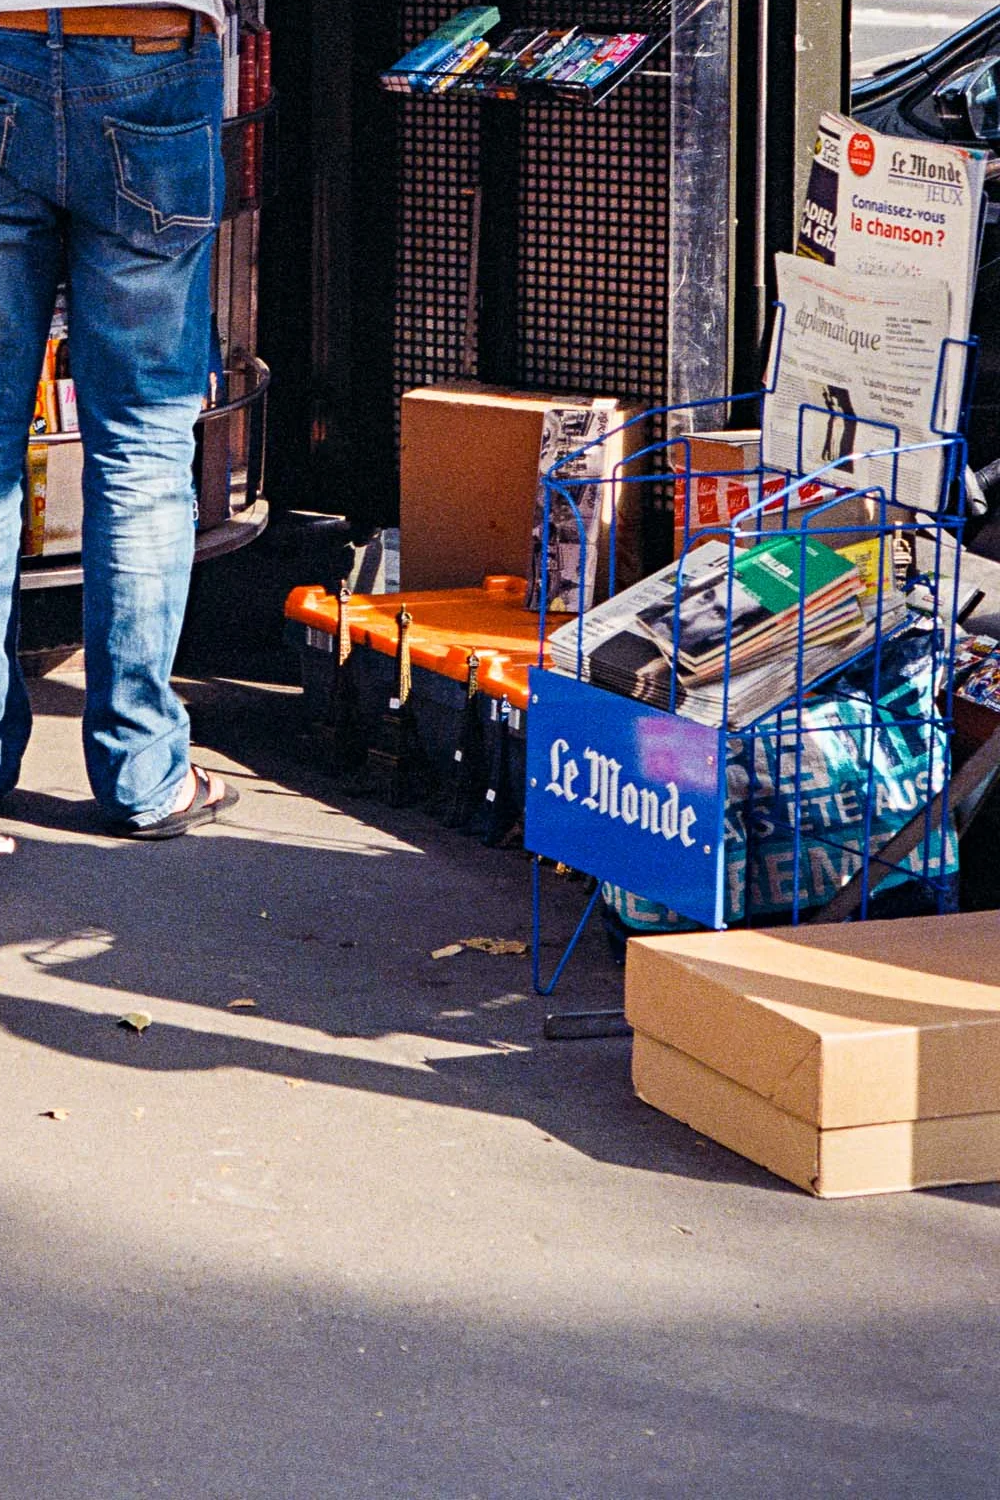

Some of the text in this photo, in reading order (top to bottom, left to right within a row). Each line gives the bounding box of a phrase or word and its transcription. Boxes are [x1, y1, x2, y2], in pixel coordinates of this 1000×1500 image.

[852, 139, 870, 150] 300
[890, 151, 906, 175] Le
[909, 153, 963, 185] Monde
[851, 194, 947, 225] Connaissez-vous
[850, 211, 864, 233] la
[866, 218, 934, 247] chanson
[794, 300, 882, 354] diplomatique
[544, 737, 698, 848] Le Monde
